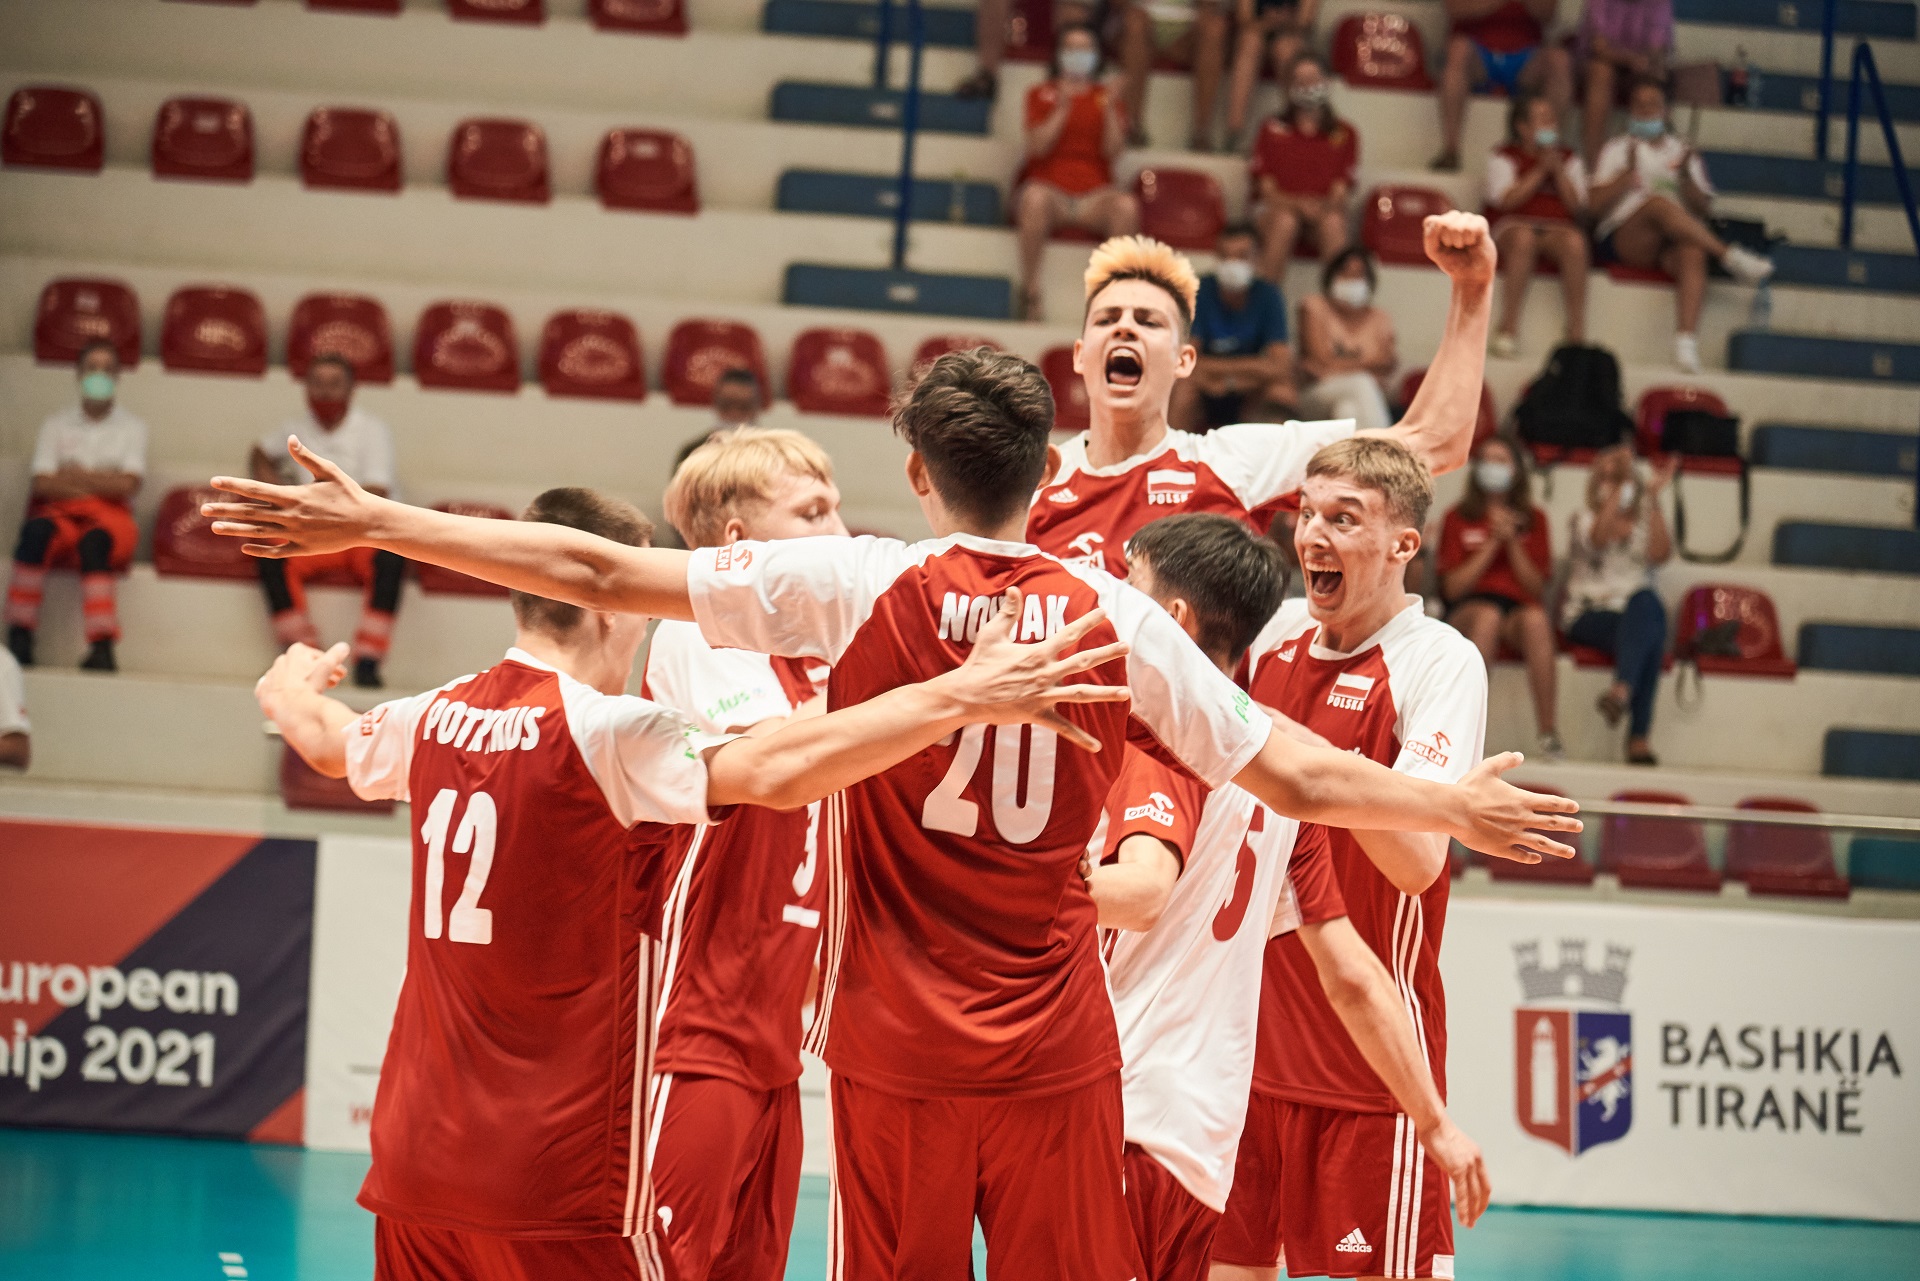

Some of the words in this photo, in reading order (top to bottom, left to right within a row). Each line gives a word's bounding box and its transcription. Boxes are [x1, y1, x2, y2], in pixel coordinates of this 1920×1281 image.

[1148, 493, 1189, 506] POLSK
[1326, 694, 1365, 712] POLSKA
[1405, 740, 1448, 767] ORLEN
[921, 722, 1058, 844] 20
[1126, 806, 1172, 825] ORLEN
[420, 788, 497, 944] 12
[80, 1025, 215, 1088] 2021
[1660, 1023, 1901, 1078] BASHKIA
[1659, 1078, 1863, 1136] TIRANË
[1335, 1243, 1372, 1253] adidas
